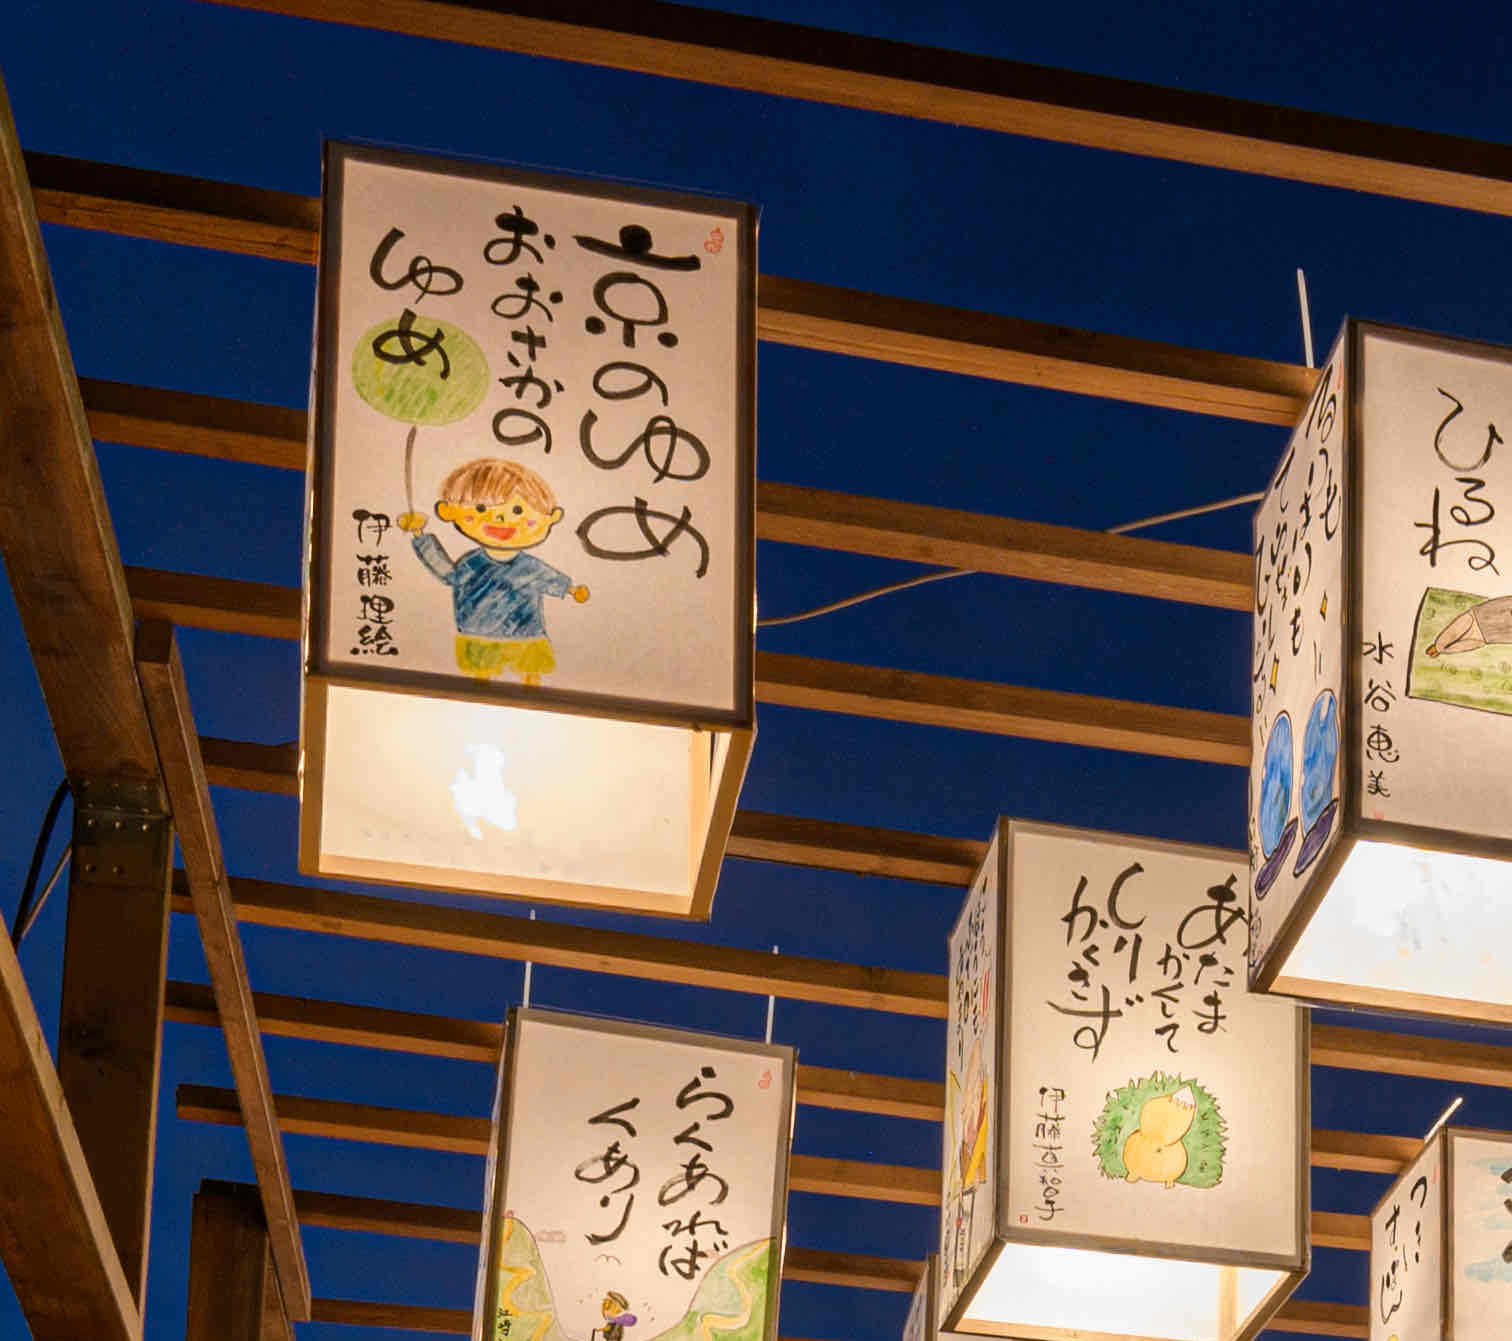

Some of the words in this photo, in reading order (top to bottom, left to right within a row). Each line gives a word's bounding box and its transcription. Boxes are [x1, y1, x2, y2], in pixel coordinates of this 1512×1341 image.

[370, 226, 464, 380] ゆめ
[483, 205, 566, 455] おおさかの
[571, 224, 711, 580] 京のゆめ
[1413, 385, 1504, 576] ひるね
[1176, 873, 1251, 1035] あたま
[574, 1096, 642, 1246] くあり
[658, 1065, 736, 1281] らくあれば
